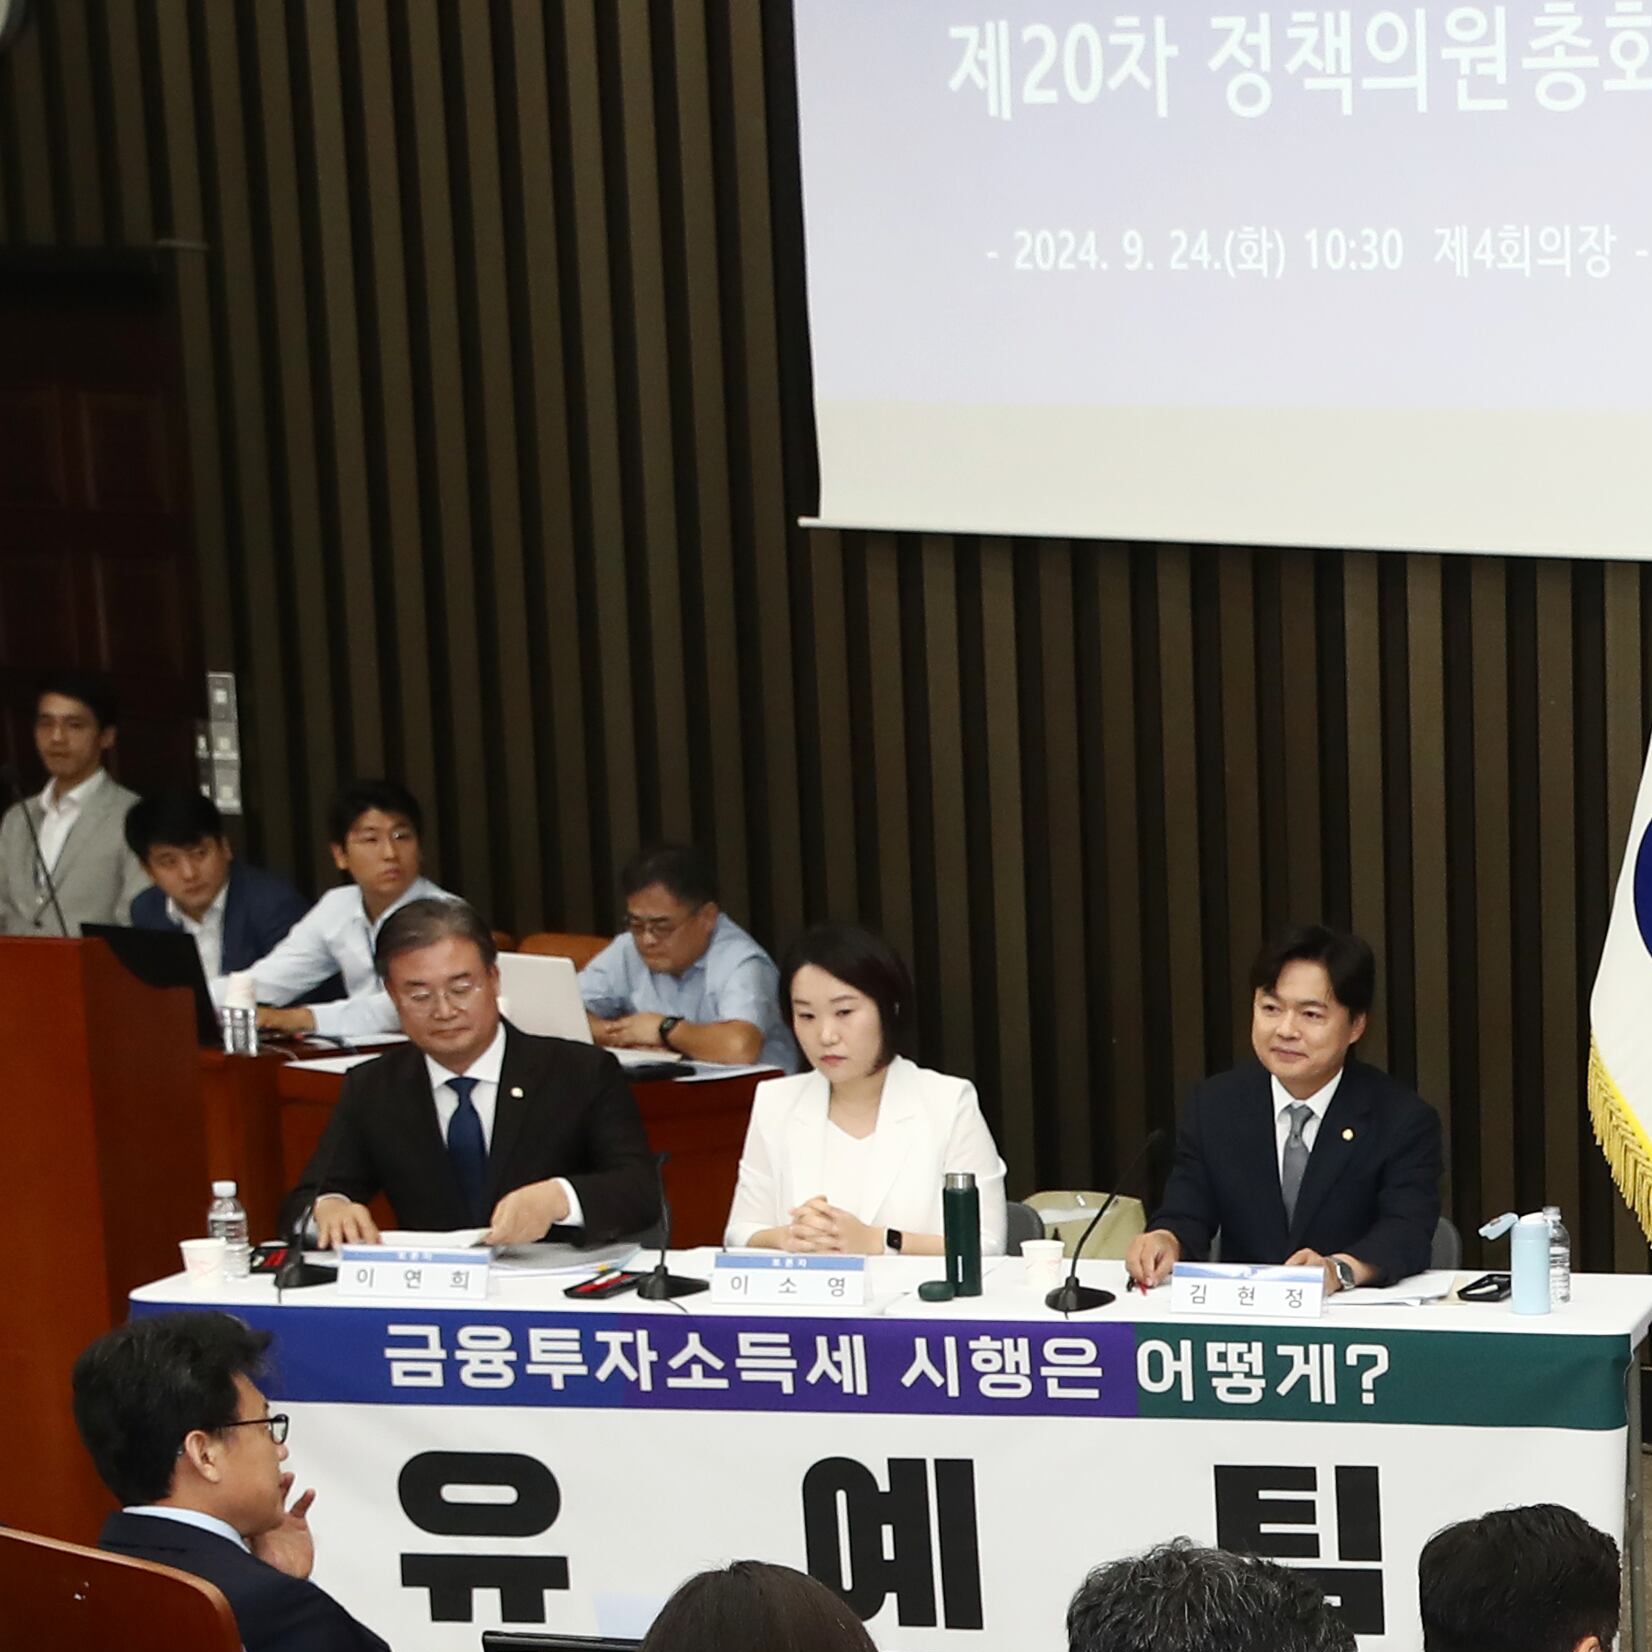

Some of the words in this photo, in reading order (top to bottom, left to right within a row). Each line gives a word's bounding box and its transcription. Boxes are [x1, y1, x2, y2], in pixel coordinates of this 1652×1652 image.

[948, 14, 1180, 121] 제20차
[1013, 228, 1109, 272] 2024.
[1121, 228, 1154, 272] 9.
[1303, 227, 1405, 272] 10:30
[1433, 223, 1618, 279] 제4회의장
[384, 1324, 868, 1396] 금융투자소득세
[900, 1335, 1103, 1400] 시행은
[1136, 1339, 1390, 1405] 어떻게?
